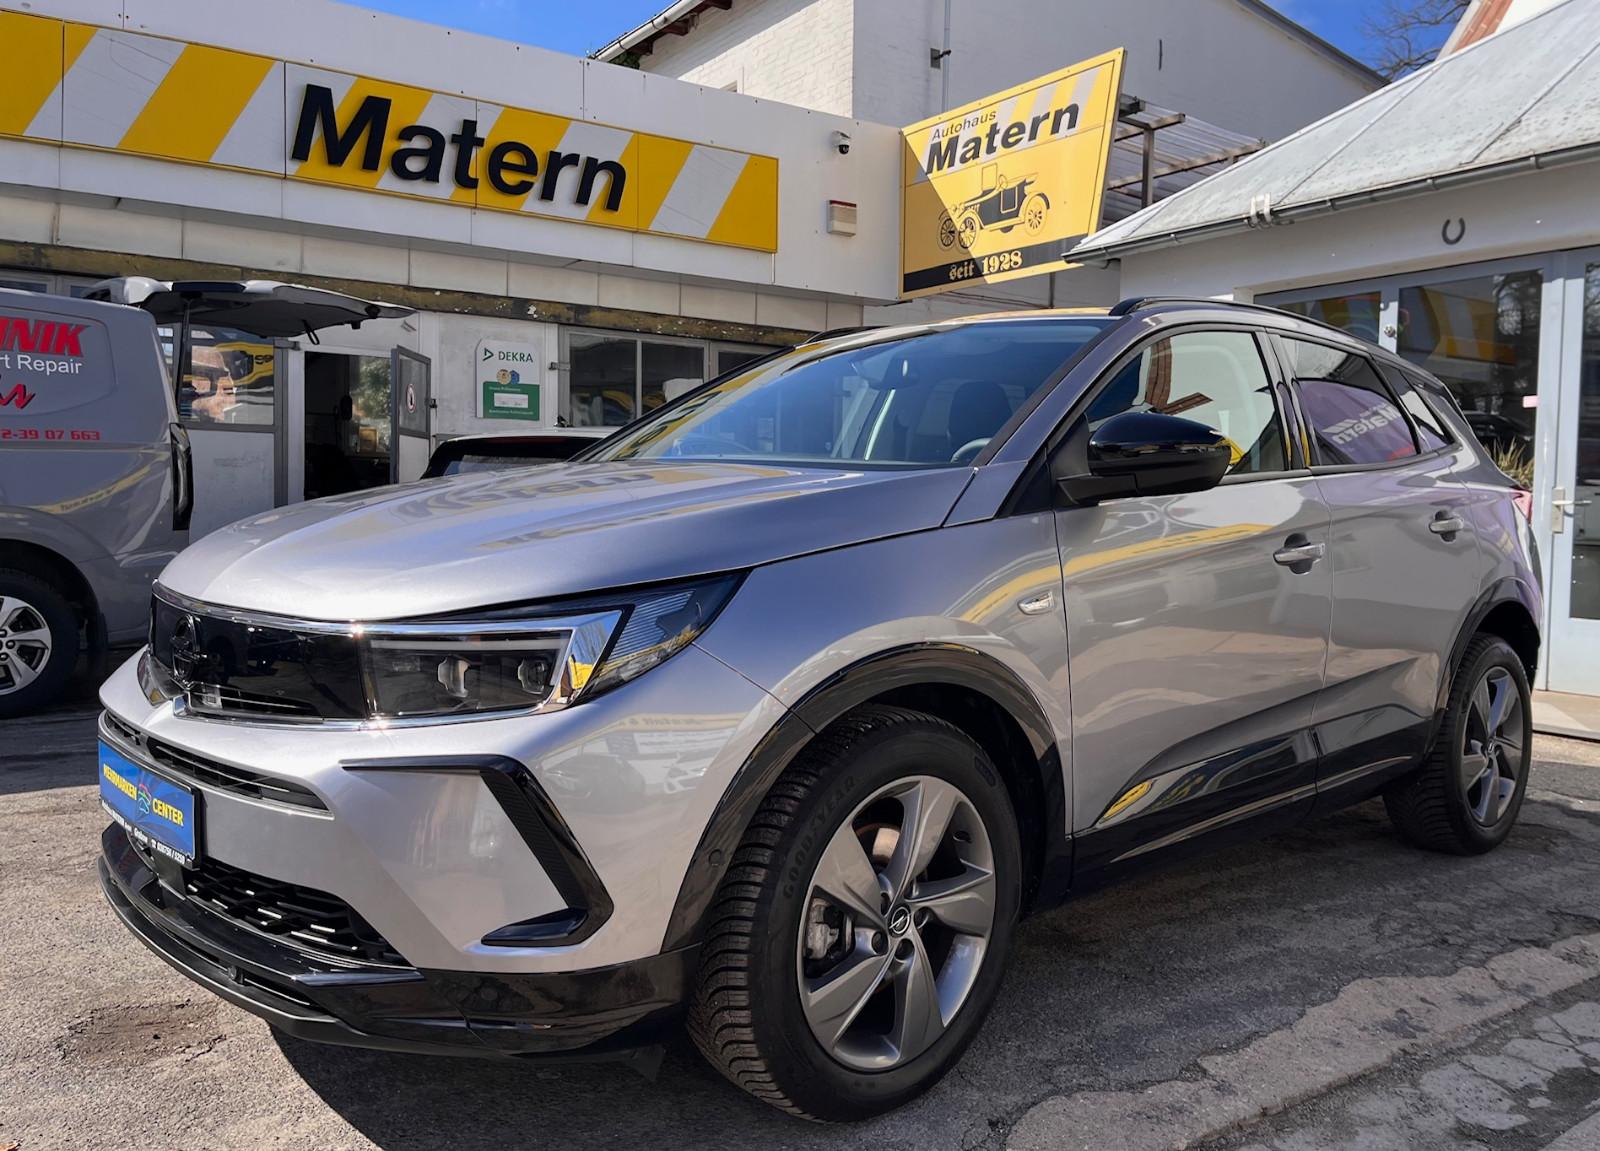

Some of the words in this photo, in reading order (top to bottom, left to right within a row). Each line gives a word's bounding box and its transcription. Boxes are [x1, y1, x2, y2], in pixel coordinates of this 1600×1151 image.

[926, 103, 1079, 175] Matern
[932, 110, 997, 141] Autohaus
[291, 83, 627, 212] Matern
[948, 261, 975, 281] seit
[981, 250, 1022, 275] 1928
[17, 354, 82, 375] Repair
[498, 350, 534, 363] DEKRA
[152, 798, 184, 827] CENTER
